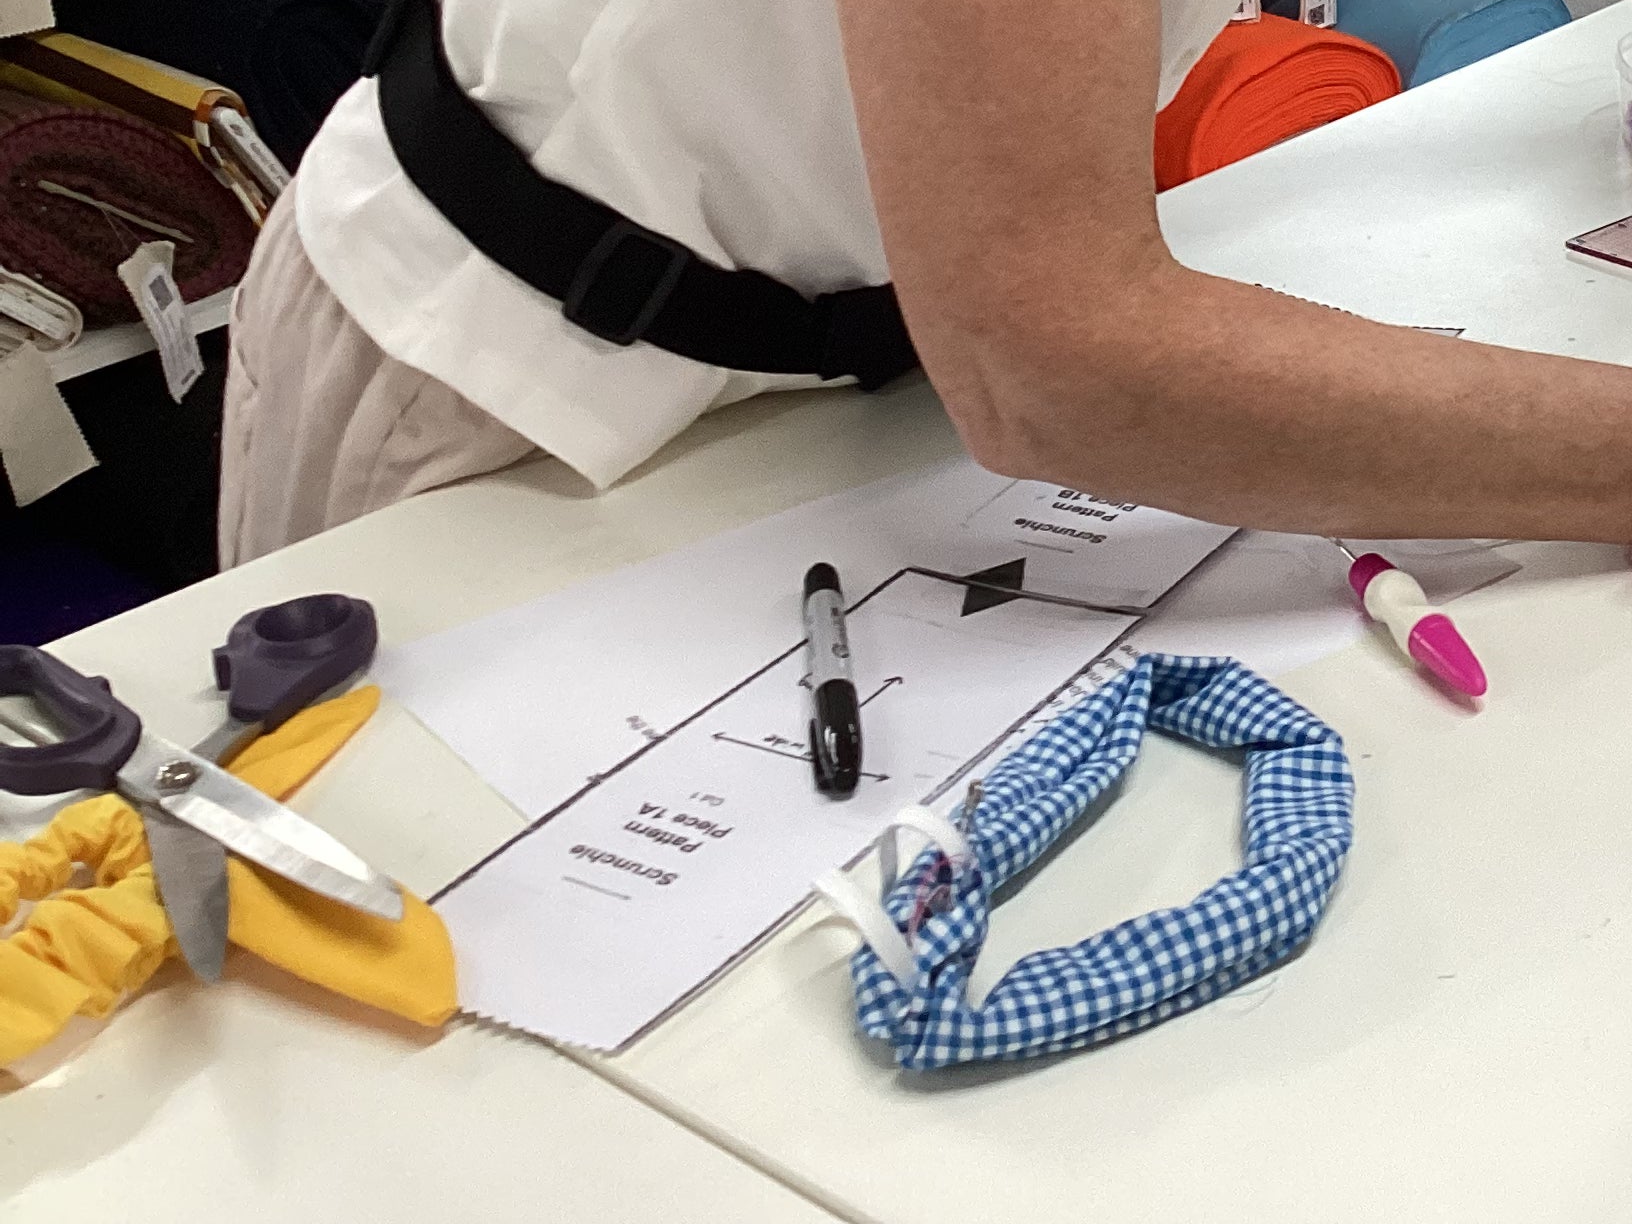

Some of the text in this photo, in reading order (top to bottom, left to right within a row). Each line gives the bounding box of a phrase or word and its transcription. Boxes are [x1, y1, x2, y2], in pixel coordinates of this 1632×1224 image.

[1051, 501, 1119, 522] Pattern
[1013, 517, 1108, 544] Scrunchie
[622, 820, 704, 854] Pattern
[637, 801, 735, 839] Piece 1A
[568, 844, 680, 886] Scrunchie
